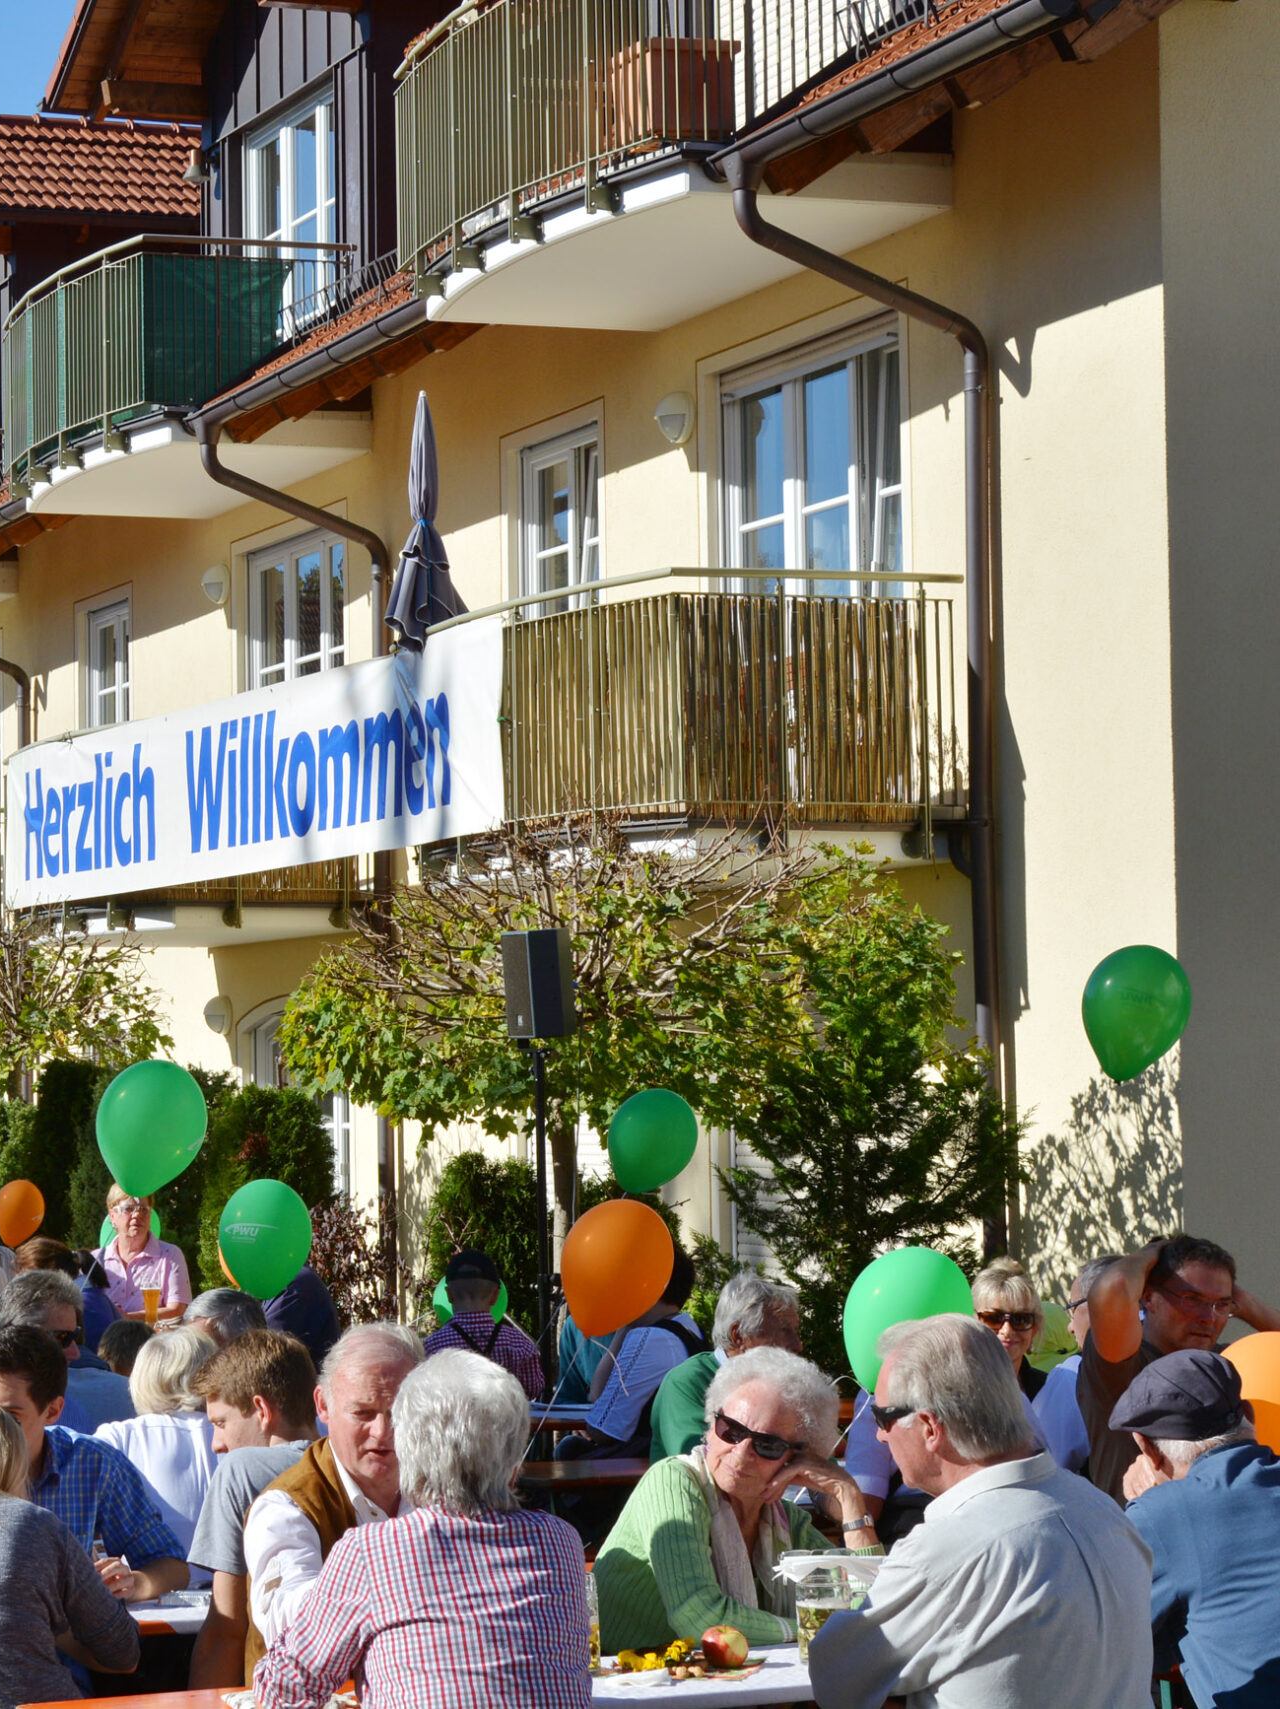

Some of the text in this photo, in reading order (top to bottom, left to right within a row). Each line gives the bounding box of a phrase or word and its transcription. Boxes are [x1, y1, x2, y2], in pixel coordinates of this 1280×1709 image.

[24, 692, 451, 881] Herzlich Willkommen
[232, 1224, 260, 1237] PWU
